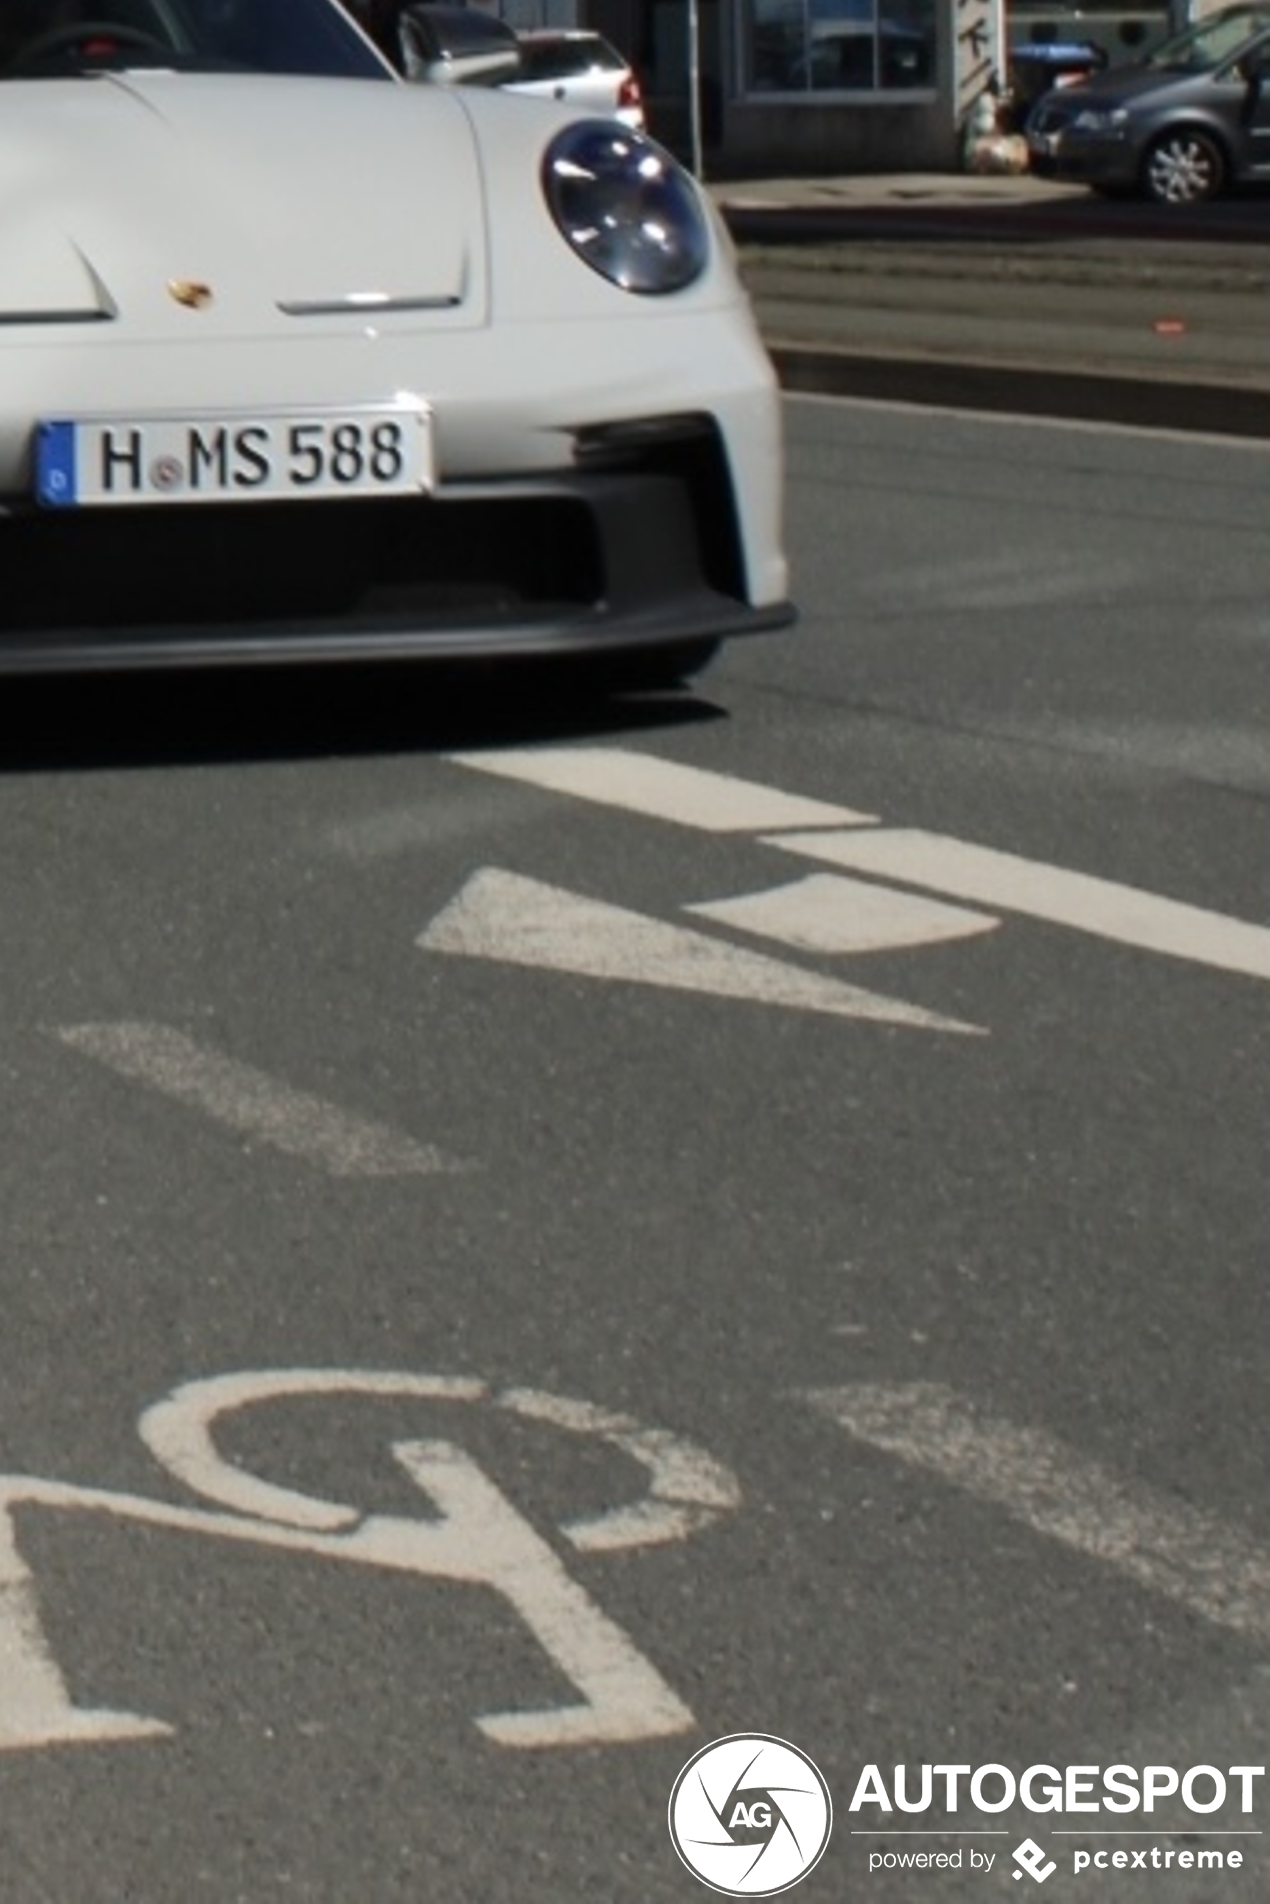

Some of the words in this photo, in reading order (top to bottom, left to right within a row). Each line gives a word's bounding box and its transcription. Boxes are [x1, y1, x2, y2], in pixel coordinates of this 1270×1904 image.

[101, 429, 142, 490] H
[189, 427, 271, 487] MS
[290, 422, 404, 485] 588
